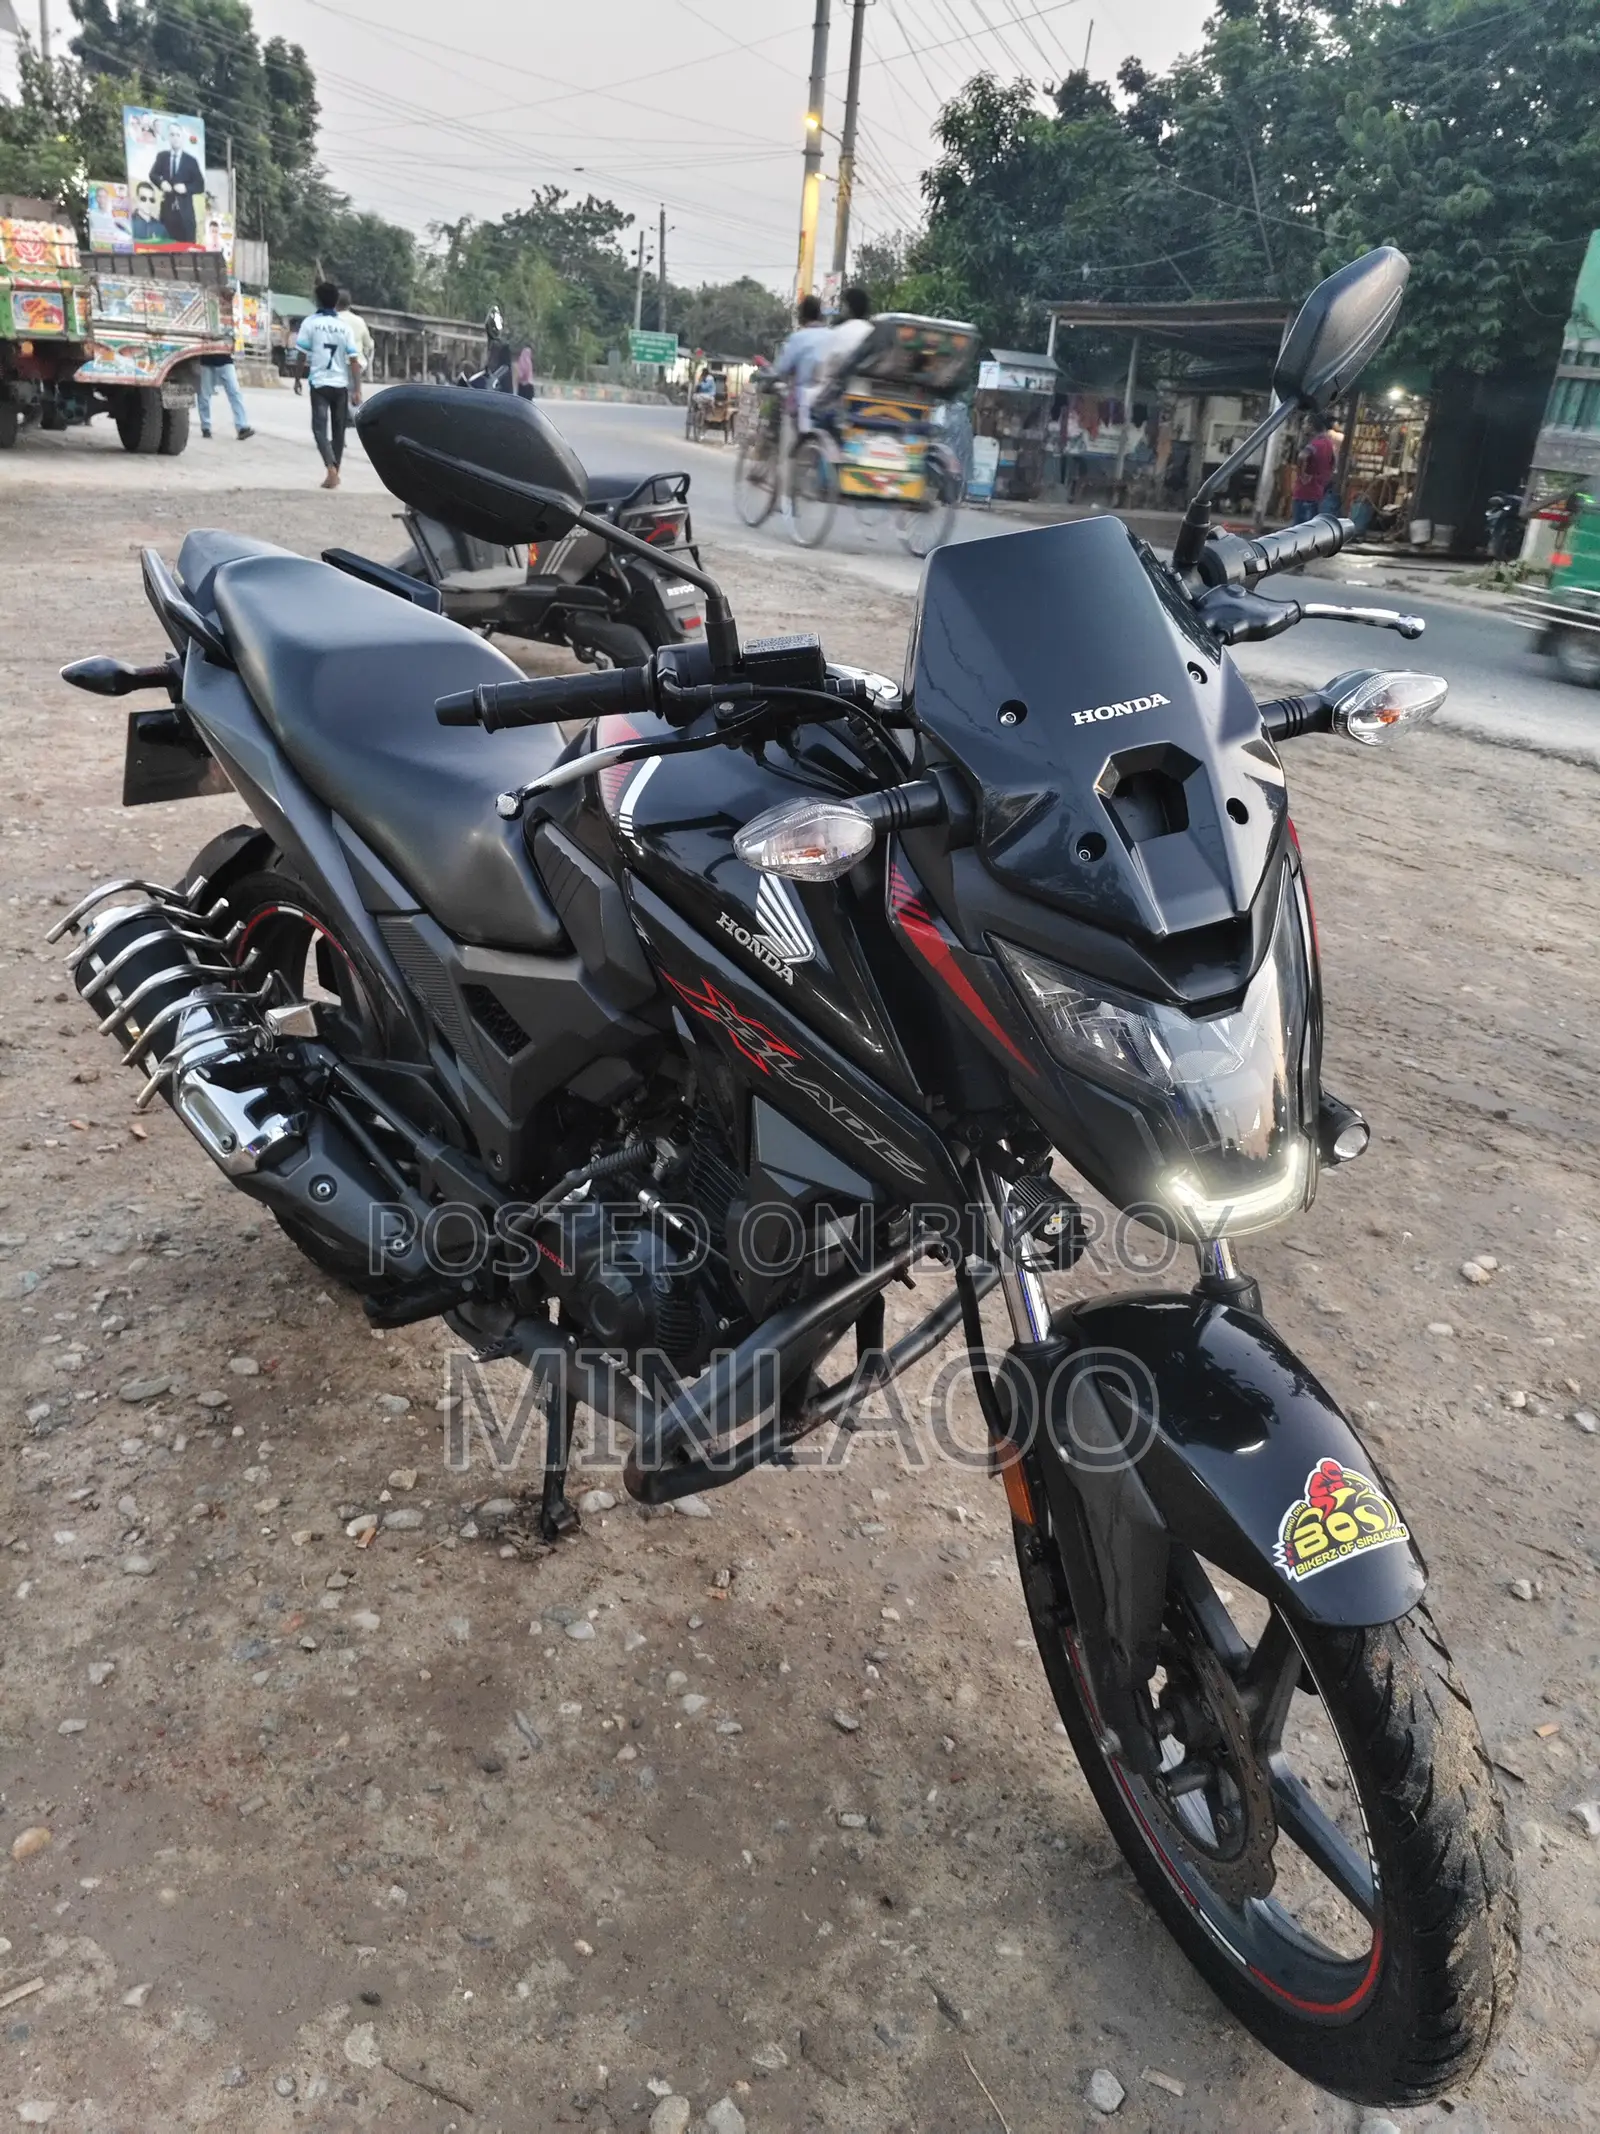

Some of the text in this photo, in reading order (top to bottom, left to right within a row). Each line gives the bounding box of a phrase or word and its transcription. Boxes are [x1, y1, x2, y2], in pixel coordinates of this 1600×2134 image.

[323, 342, 338, 370] 7
[1070, 693, 1171, 726] HONDA
[716, 911, 794, 987] HONDA
[1295, 1547, 1338, 1575] BIKERZ
[1338, 1540, 1356, 1555] OF
